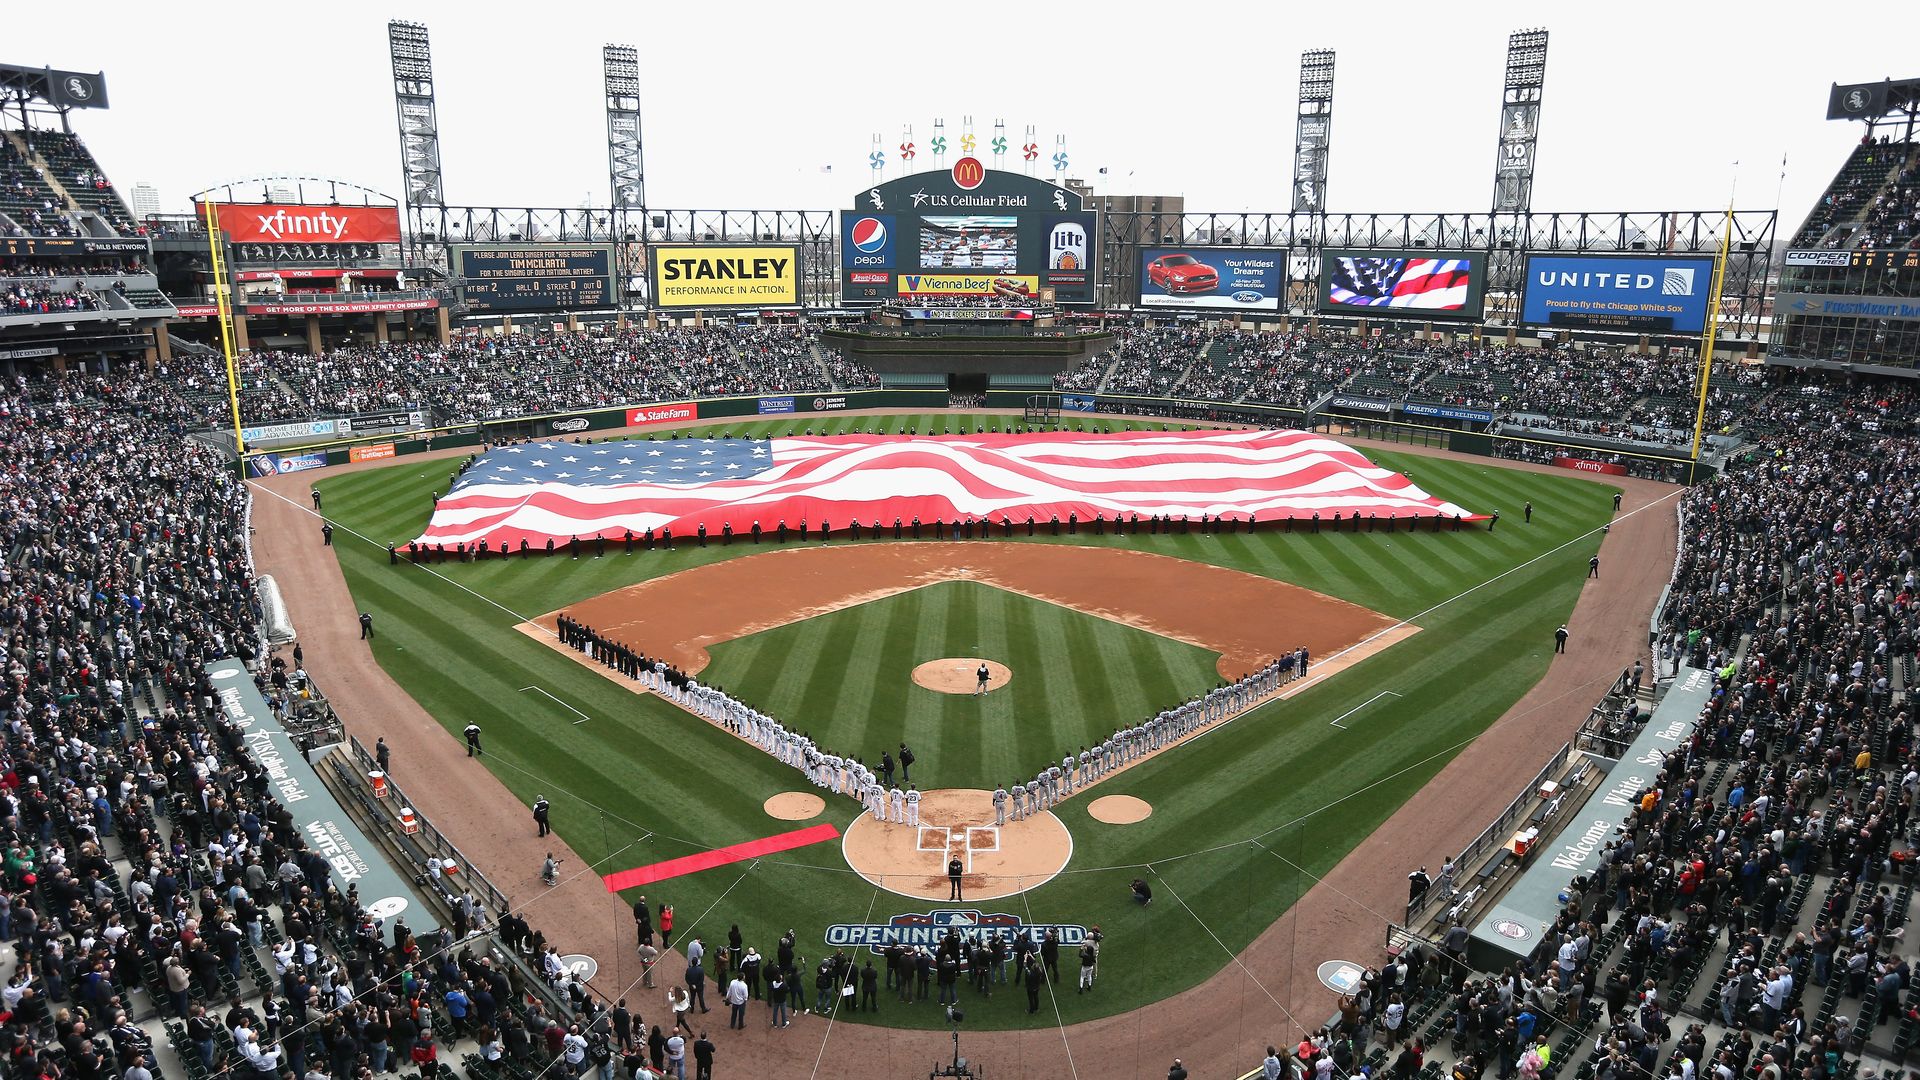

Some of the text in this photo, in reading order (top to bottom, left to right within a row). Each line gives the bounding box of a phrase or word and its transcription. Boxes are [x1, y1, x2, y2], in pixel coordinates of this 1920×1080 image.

[1507, 144, 1525, 158] 10
[931, 196, 1027, 207] U.S. Cellular Field
[258, 210, 348, 239] xfinity
[1054, 232, 1083, 250] Lite
[510, 259, 566, 268] TIM MCILRATH
[855, 255, 885, 265] pepsi
[664, 259, 788, 280] STANLEY
[571, 281, 576, 289] 0
[596, 280, 601, 288] 0
[924, 278, 990, 292] Vienna Beef
[1540, 272, 1654, 288] UNITED
[492, 283, 497, 291] 2
[534, 282, 539, 290] 0
[666, 286, 734, 295] PERFORMANCE
[1238, 293, 1257, 301] Ford
[1580, 301, 1590, 309] fly
[1608, 302, 1638, 312] Chicago
[1348, 400, 1386, 410] HYUNDAI
[1406, 404, 1438, 413] ATHLETICO
[1455, 412, 1489, 420] RELIEVERS
[265, 430, 310, 439] ADVANTAGE
[1574, 461, 1603, 472] xfinity
[220, 687, 255, 728] Welcome To
[276, 777, 310, 803] Field
[1550, 820, 1611, 871] Welcome
[1602, 775, 1645, 807] White
[1655, 720, 1686, 741] Fans
[306, 820, 362, 883] WHITE SOX
[830, 926, 947, 944] OPENING
